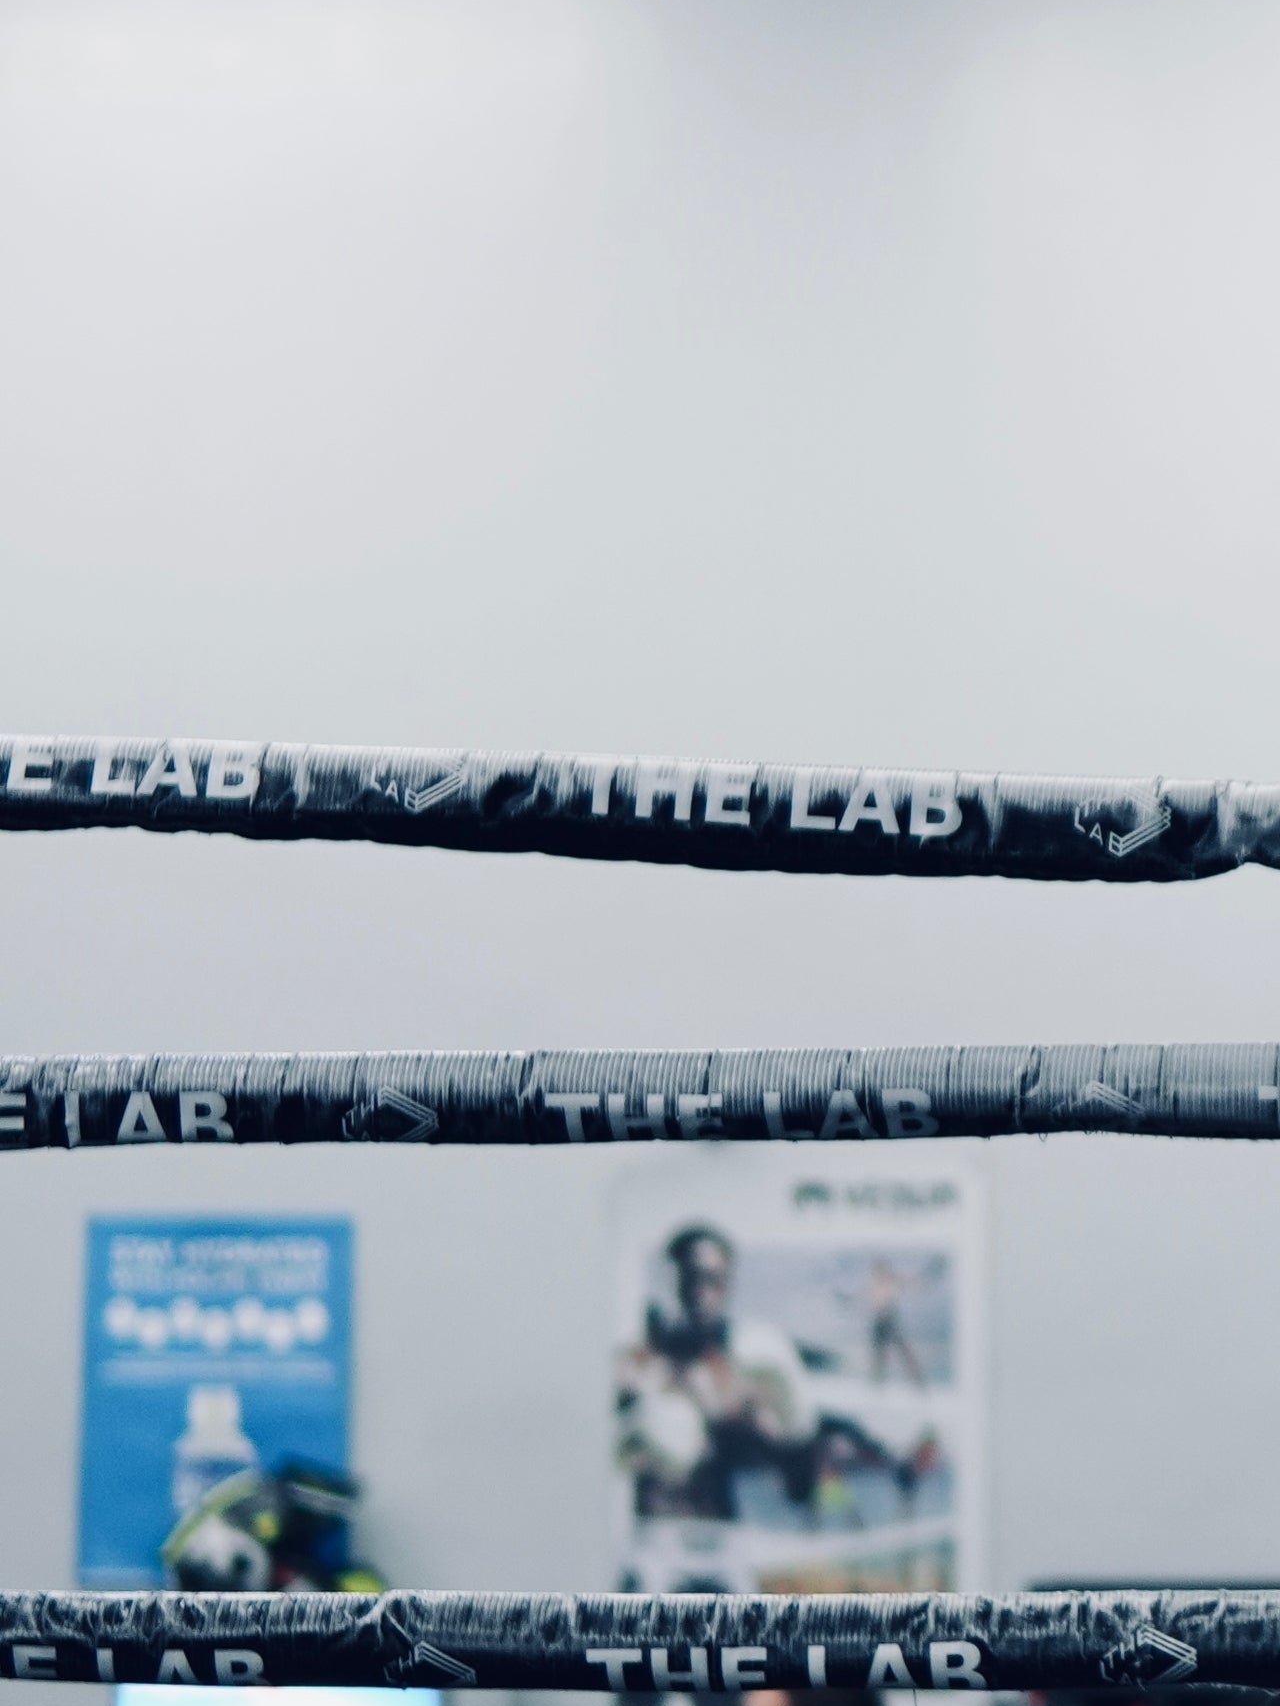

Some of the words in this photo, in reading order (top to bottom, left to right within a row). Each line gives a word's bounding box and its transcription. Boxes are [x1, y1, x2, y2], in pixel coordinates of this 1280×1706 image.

[90, 739, 261, 799] LAB
[578, 757, 751, 826] THE
[790, 767, 963, 837] LAB
[64, 1090, 235, 1147] LAB
[544, 1093, 723, 1142] THE
[764, 1087, 941, 1139] LAB
[585, 1646, 768, 1691] THE
